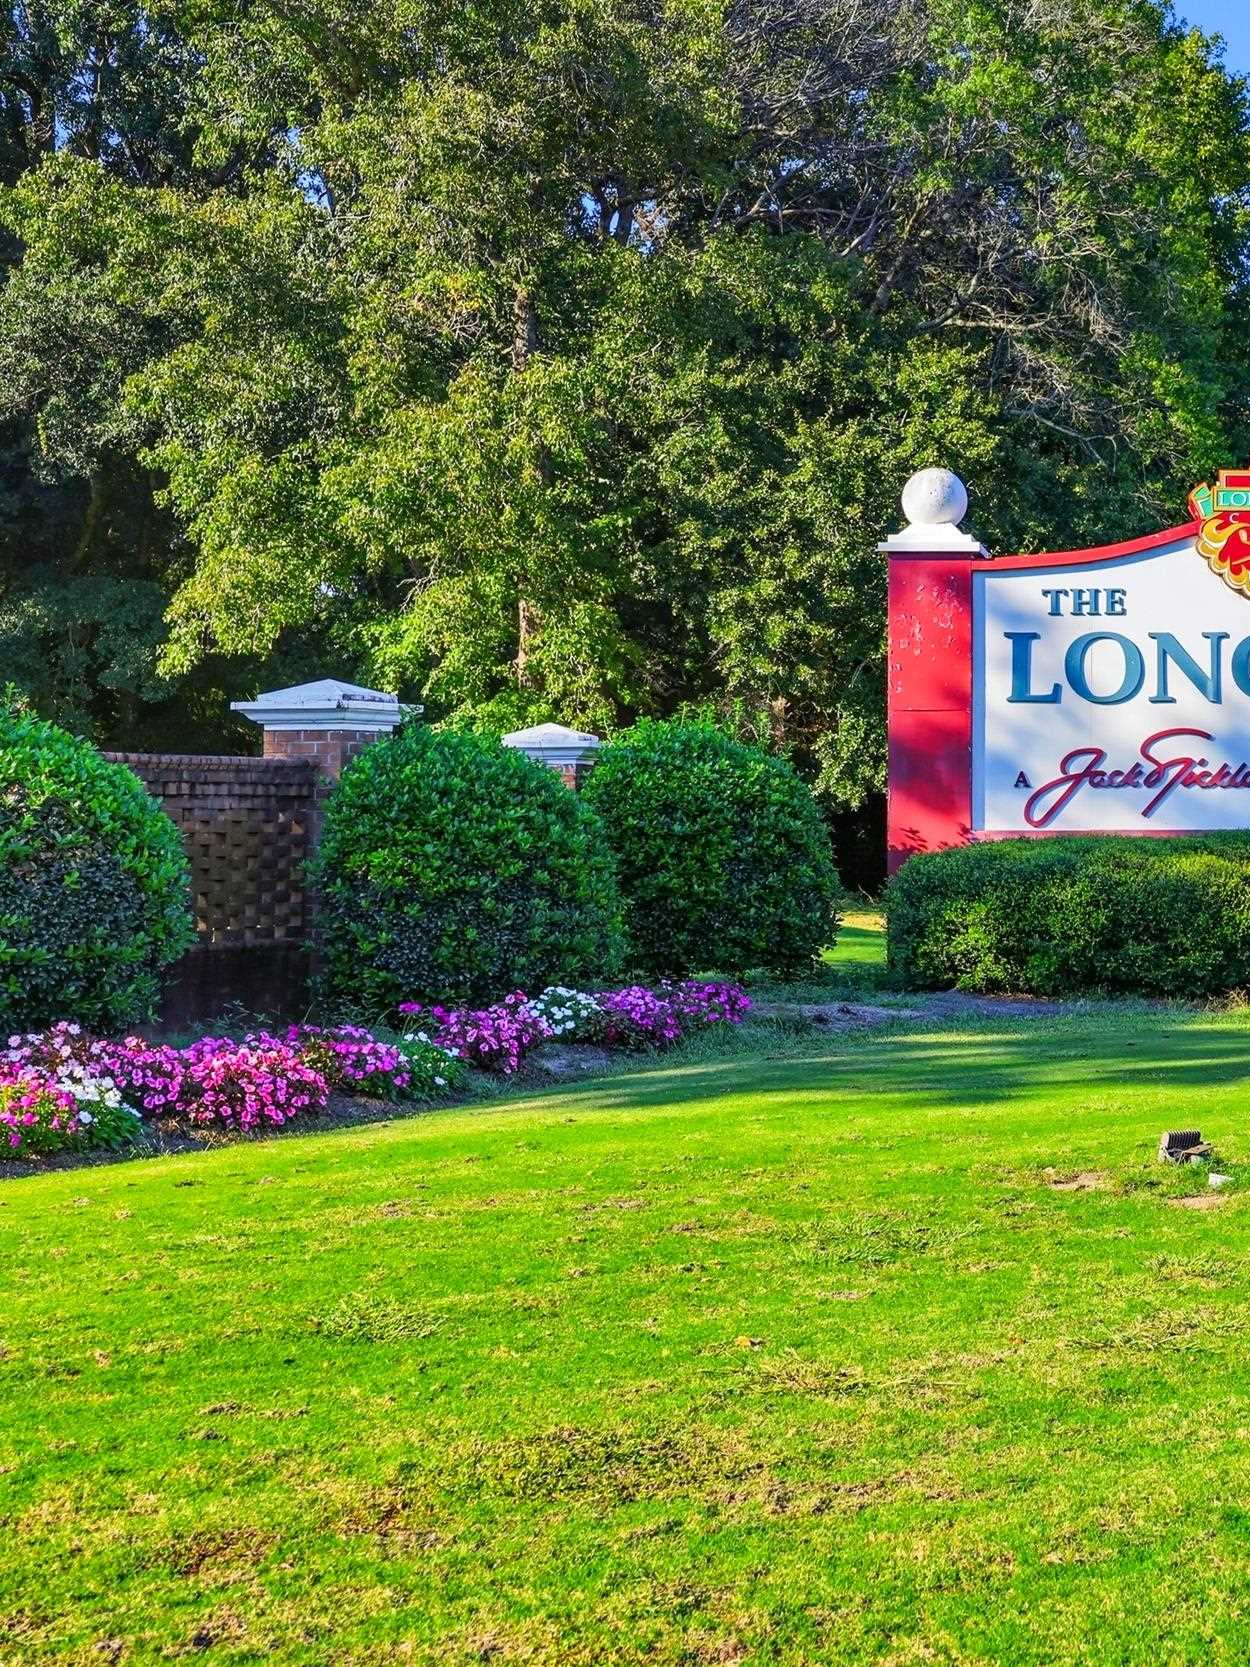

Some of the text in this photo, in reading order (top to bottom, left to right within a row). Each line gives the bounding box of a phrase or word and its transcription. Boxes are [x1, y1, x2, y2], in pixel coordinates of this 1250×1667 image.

[1041, 588, 1127, 617] THE
[1014, 770, 1032, 788] A
[1024, 747, 1143, 828] Jack
